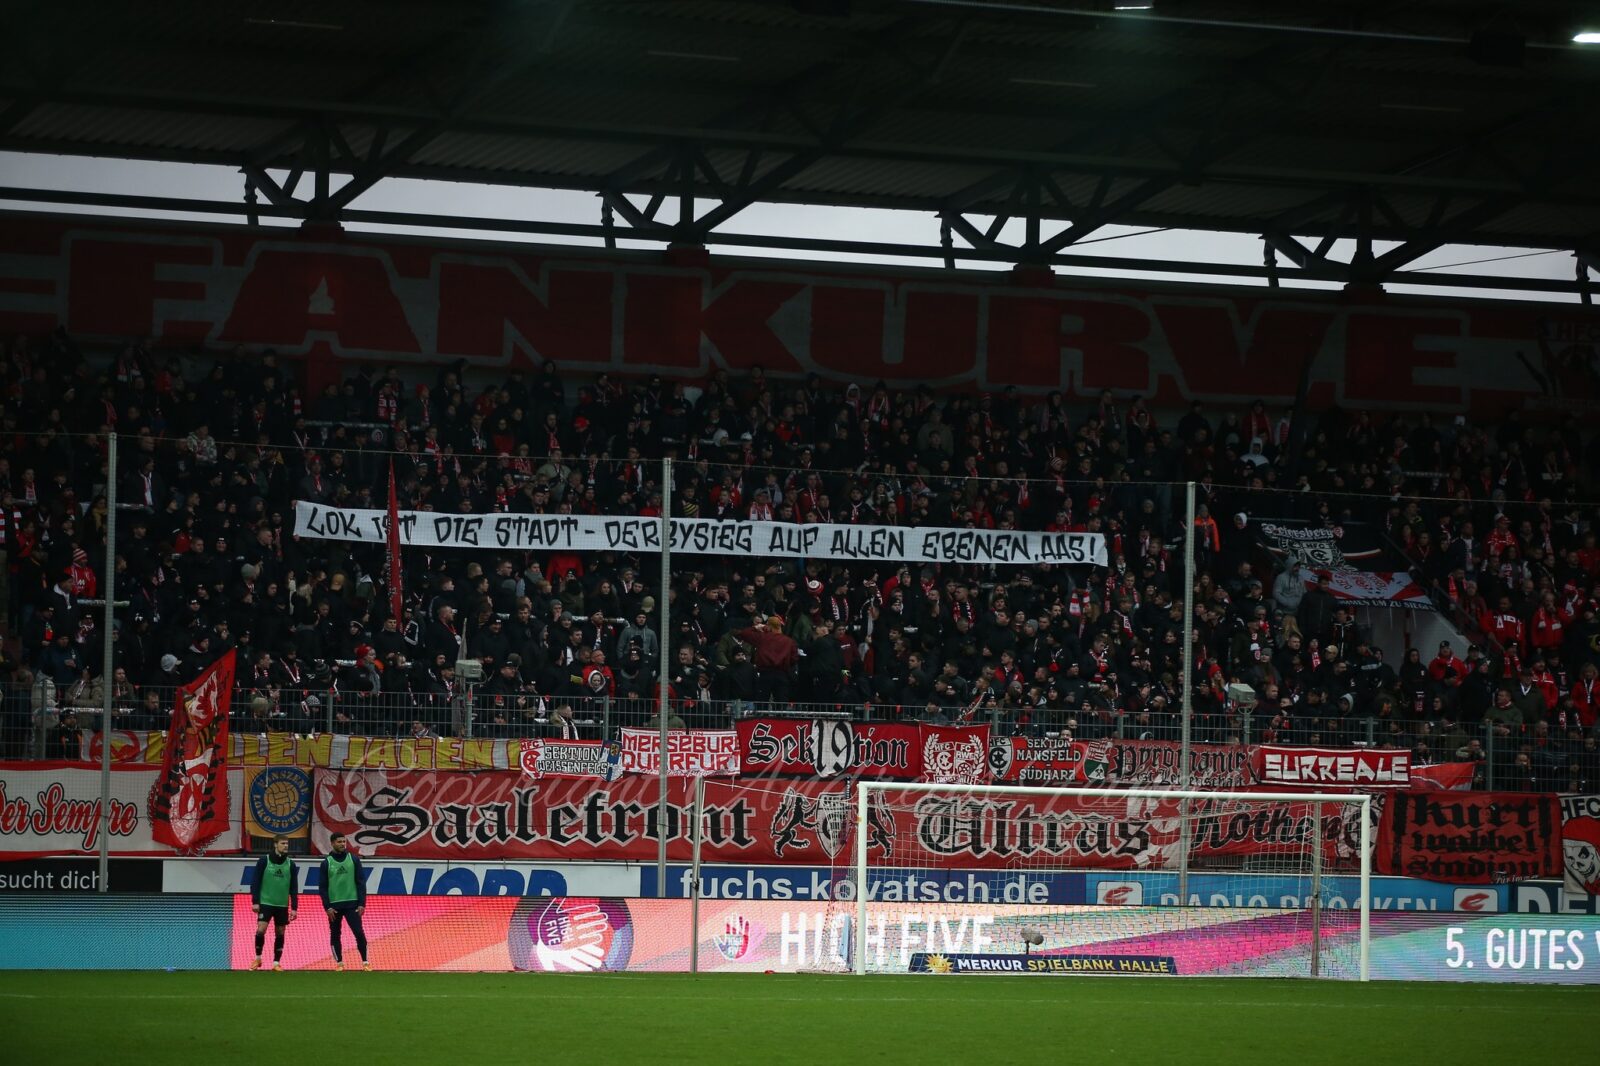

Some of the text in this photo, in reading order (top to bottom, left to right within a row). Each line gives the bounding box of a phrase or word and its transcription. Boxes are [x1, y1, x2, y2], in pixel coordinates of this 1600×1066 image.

[62, 229, 1471, 410] FANKURVE
[306, 507, 362, 540] LOK
[433, 516, 483, 546] DIE
[496, 516, 578, 547] STADT
[769, 525, 819, 555] AUF
[831, 529, 905, 558] ALLEN
[343, 736, 495, 769] JAGEN
[543, 745, 600, 761] SEKTION
[1027, 738, 1072, 749] SEKTION
[1016, 750, 1082, 762] MANSFELD
[1265, 752, 1409, 782] SURREALE
[1018, 766, 1076, 781] SÜDHARZ
[1160, 769, 1244, 787] Leienschaft
[354, 785, 756, 848] Saalefront
[0, 870, 54, 889] sucht
[680, 869, 1050, 904] fuchs-kovatsch.de
[1446, 928, 1474, 968] 5.
[1486, 928, 1585, 970] GUTES
[957, 957, 1169, 973] MERKUR SPIELBANK HALLE
